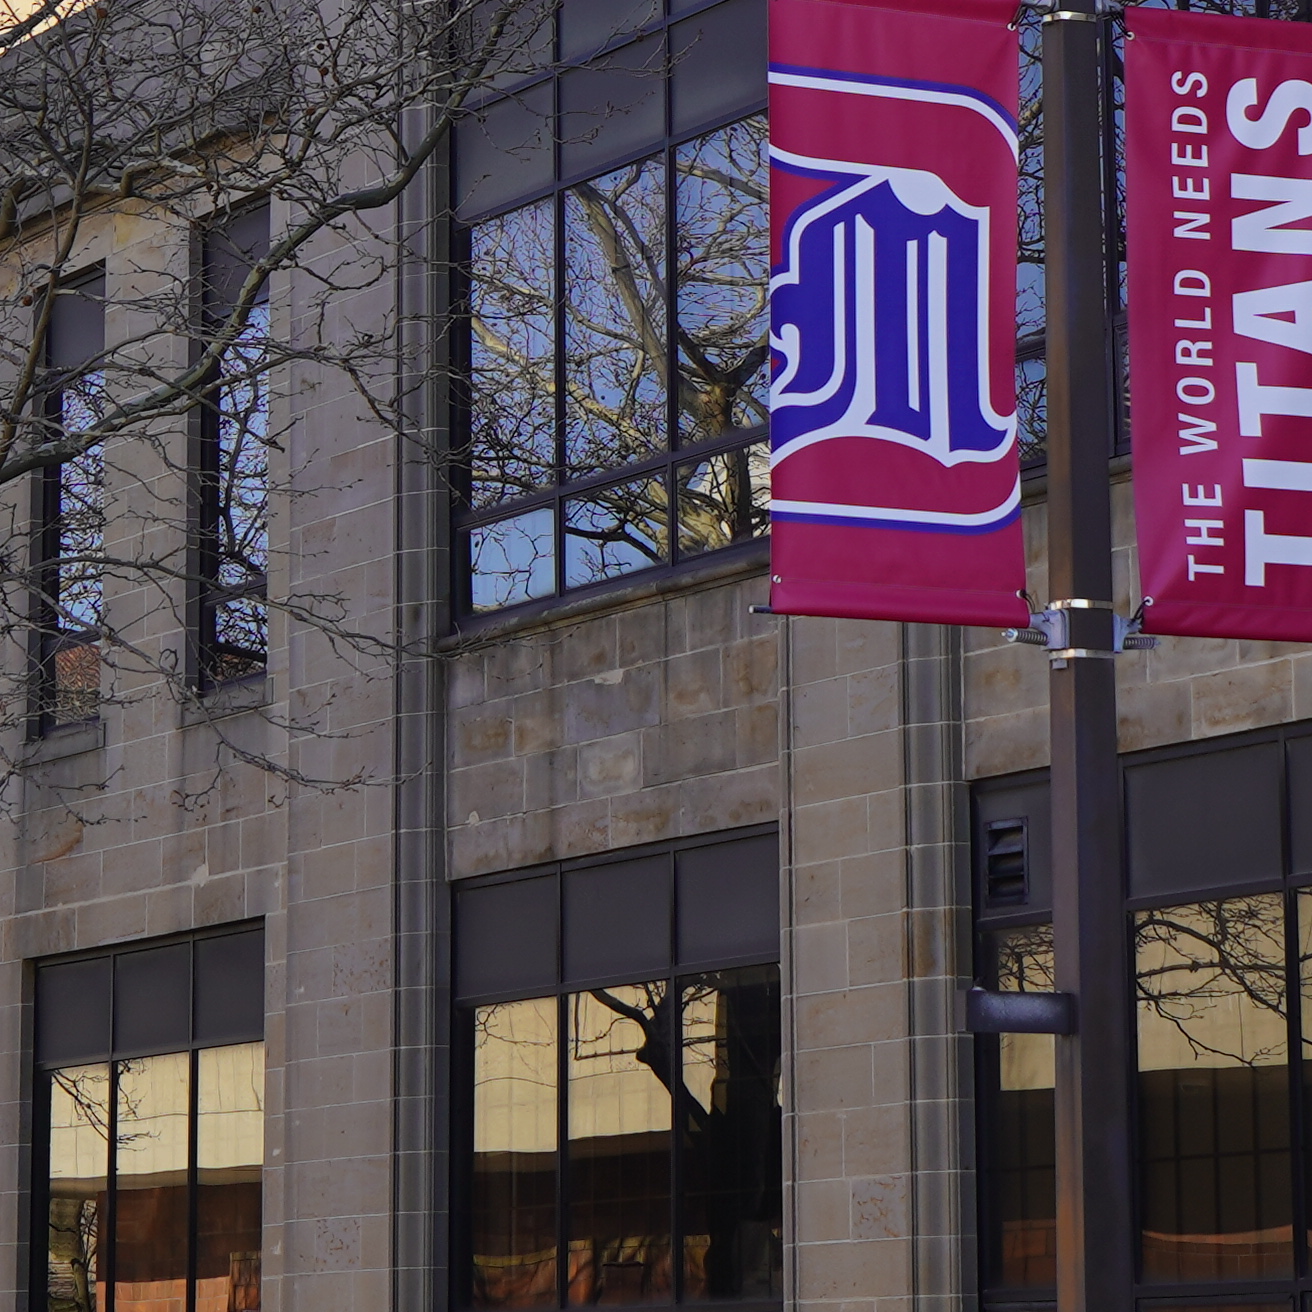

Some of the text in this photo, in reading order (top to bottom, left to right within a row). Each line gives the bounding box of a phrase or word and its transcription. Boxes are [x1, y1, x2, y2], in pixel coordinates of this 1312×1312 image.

[1171, 70, 1225, 582] THE WORLD NEEDS
